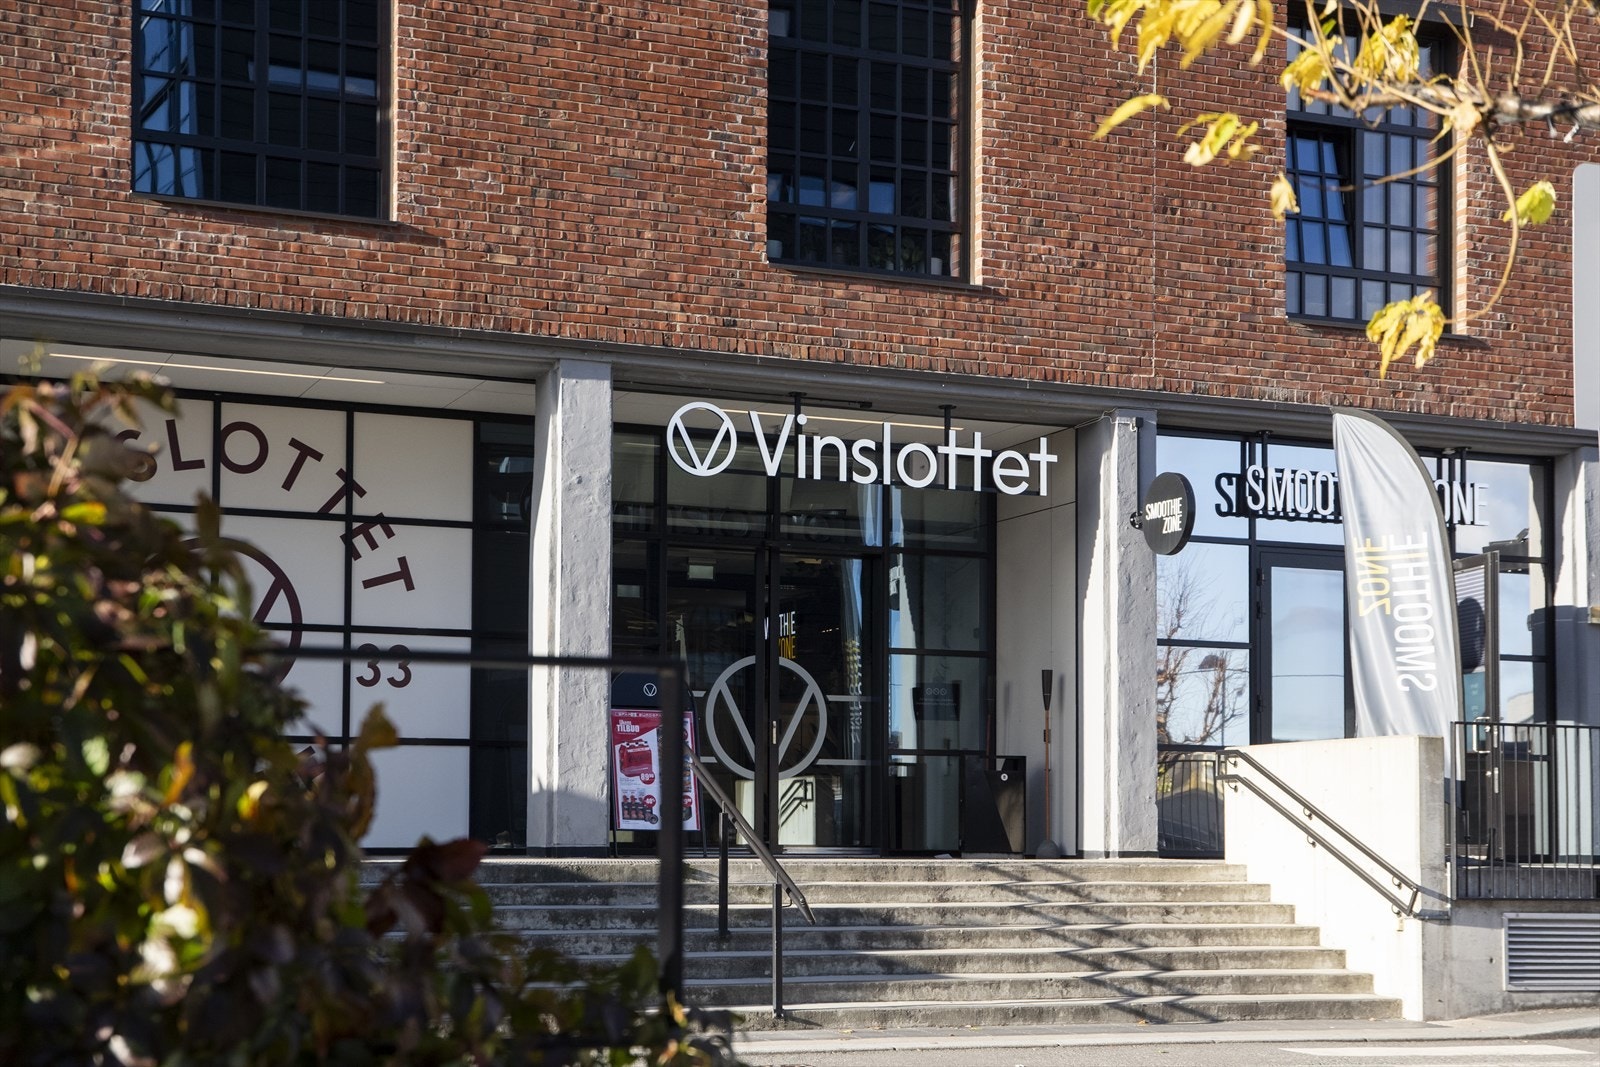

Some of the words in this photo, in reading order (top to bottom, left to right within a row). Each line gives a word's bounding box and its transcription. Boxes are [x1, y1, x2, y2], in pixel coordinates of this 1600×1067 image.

[749, 411, 1058, 497] Vinslottet
[116, 419, 415, 592] SLOTTET
[1145, 497, 1183, 520] SMOOTHIE
[1246, 464, 1341, 516] SMOO
[1436, 479, 1490, 526] ONE
[1162, 515, 1183, 534] ZONE
[779, 636, 796, 659] ONE
[355, 643, 413, 688] 33
[616, 724, 640, 733] TILBUD
